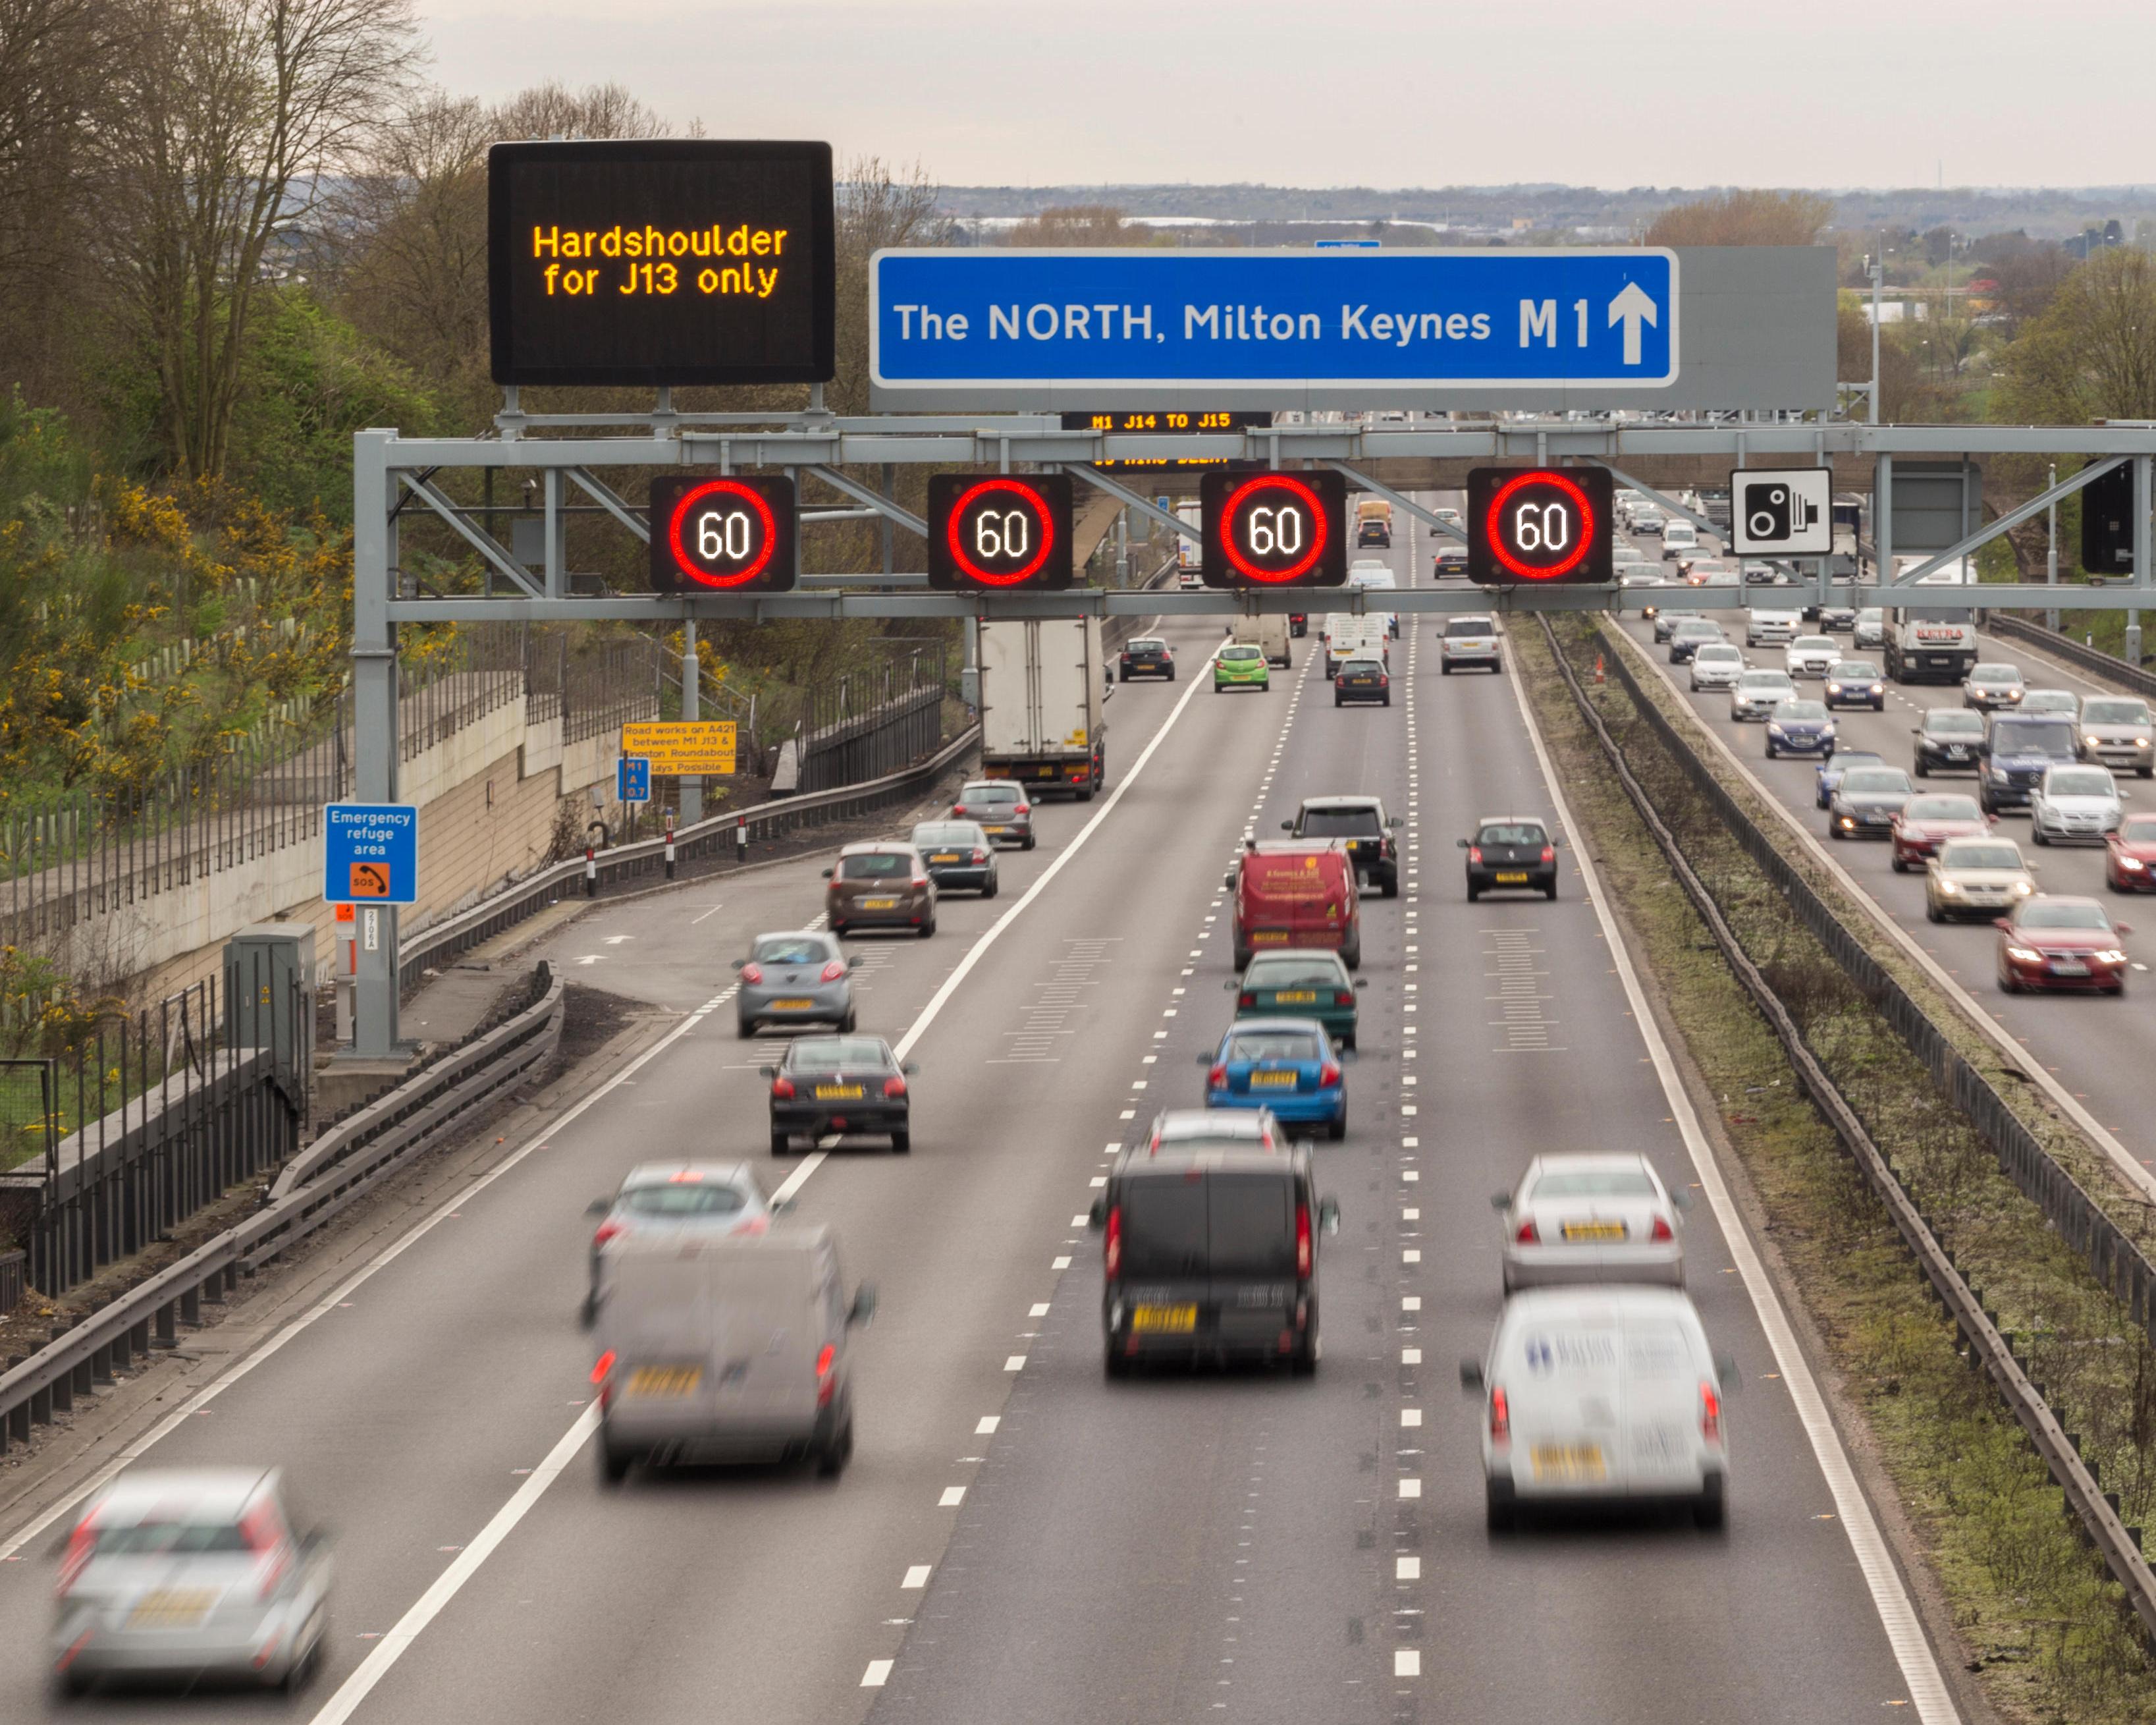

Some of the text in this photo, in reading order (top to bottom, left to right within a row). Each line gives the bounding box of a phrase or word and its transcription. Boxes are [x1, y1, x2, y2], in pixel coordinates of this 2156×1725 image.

[533, 224, 788, 257] Hardshoulder
[543, 262, 778, 298] for J13 only
[893, 304, 969, 340] The
[989, 303, 1165, 344] NORTH,
[1185, 304, 1321, 340] Milton
[1341, 304, 1492, 347] Keynes
[1092, 413, 1231, 429] M1 J14 TO J15
[976, 510, 1028, 558] 60
[1249, 507, 1301, 555] 60
[1515, 503, 1568, 551] 60
[698, 511, 749, 560] 60
[655, 725, 687, 734] works
[709, 725, 735, 734] A421
[633, 738, 679, 746] between
[701, 736, 717, 745] J13
[721, 736, 728, 745] &
[624, 748, 735, 758] ingston Roundabout
[651, 763, 722, 773] lays Possible
[331, 811, 410, 827] Emergency
[347, 827, 394, 842] refuge
[354, 845, 386, 855] area
[353, 878, 374, 887] SOS
